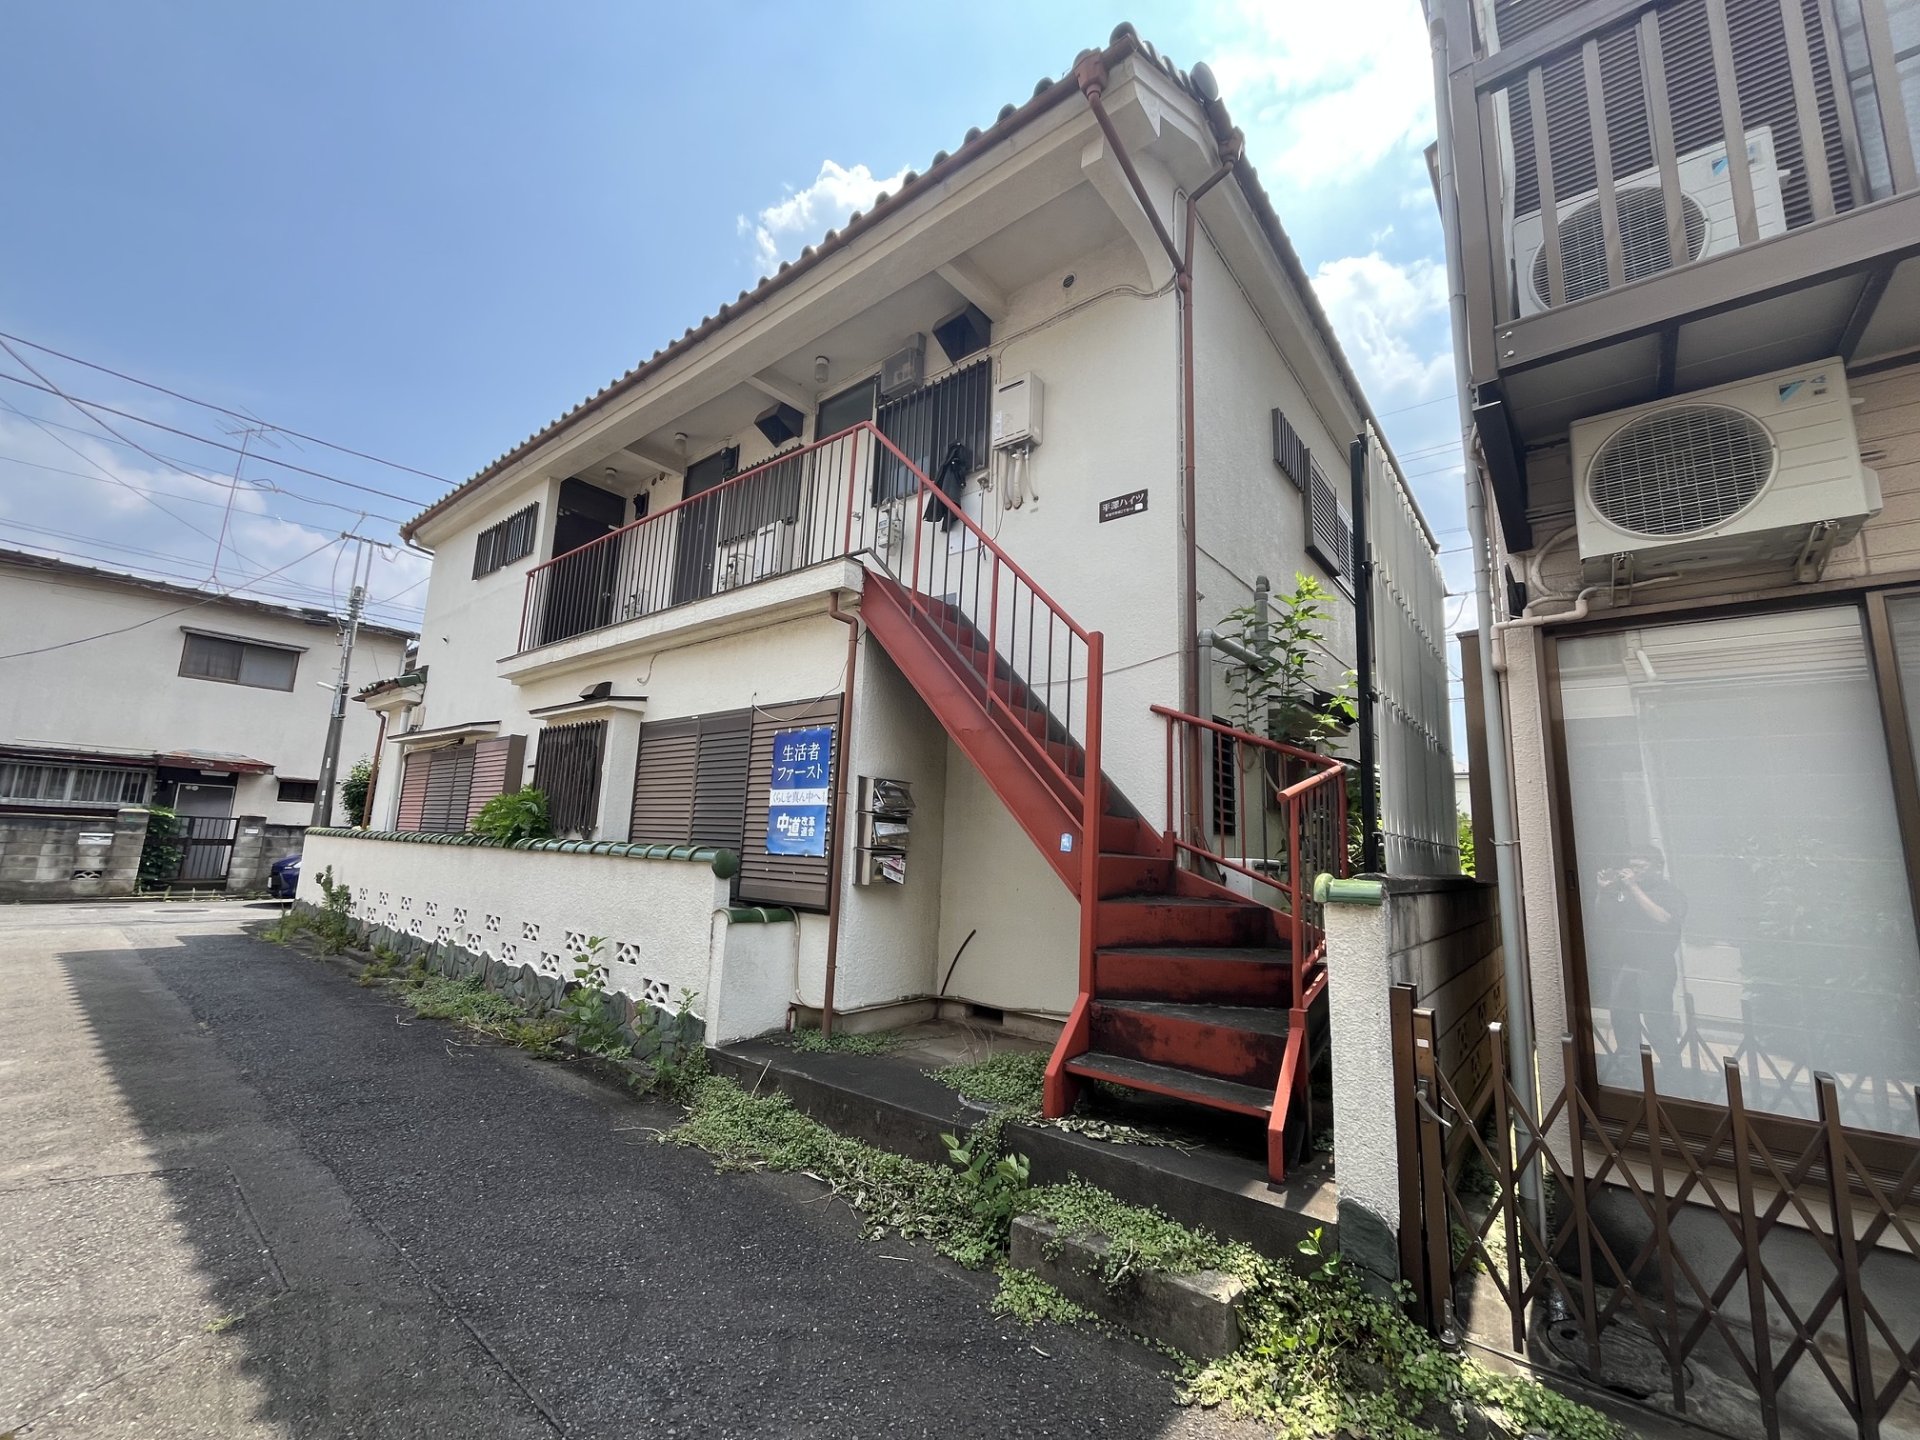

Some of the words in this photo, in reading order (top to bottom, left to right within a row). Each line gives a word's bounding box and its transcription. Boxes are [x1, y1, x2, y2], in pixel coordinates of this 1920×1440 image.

[782, 742, 820, 762] 生活者
[777, 763, 823, 781] ファースト
[776, 813, 801, 836] 中道
